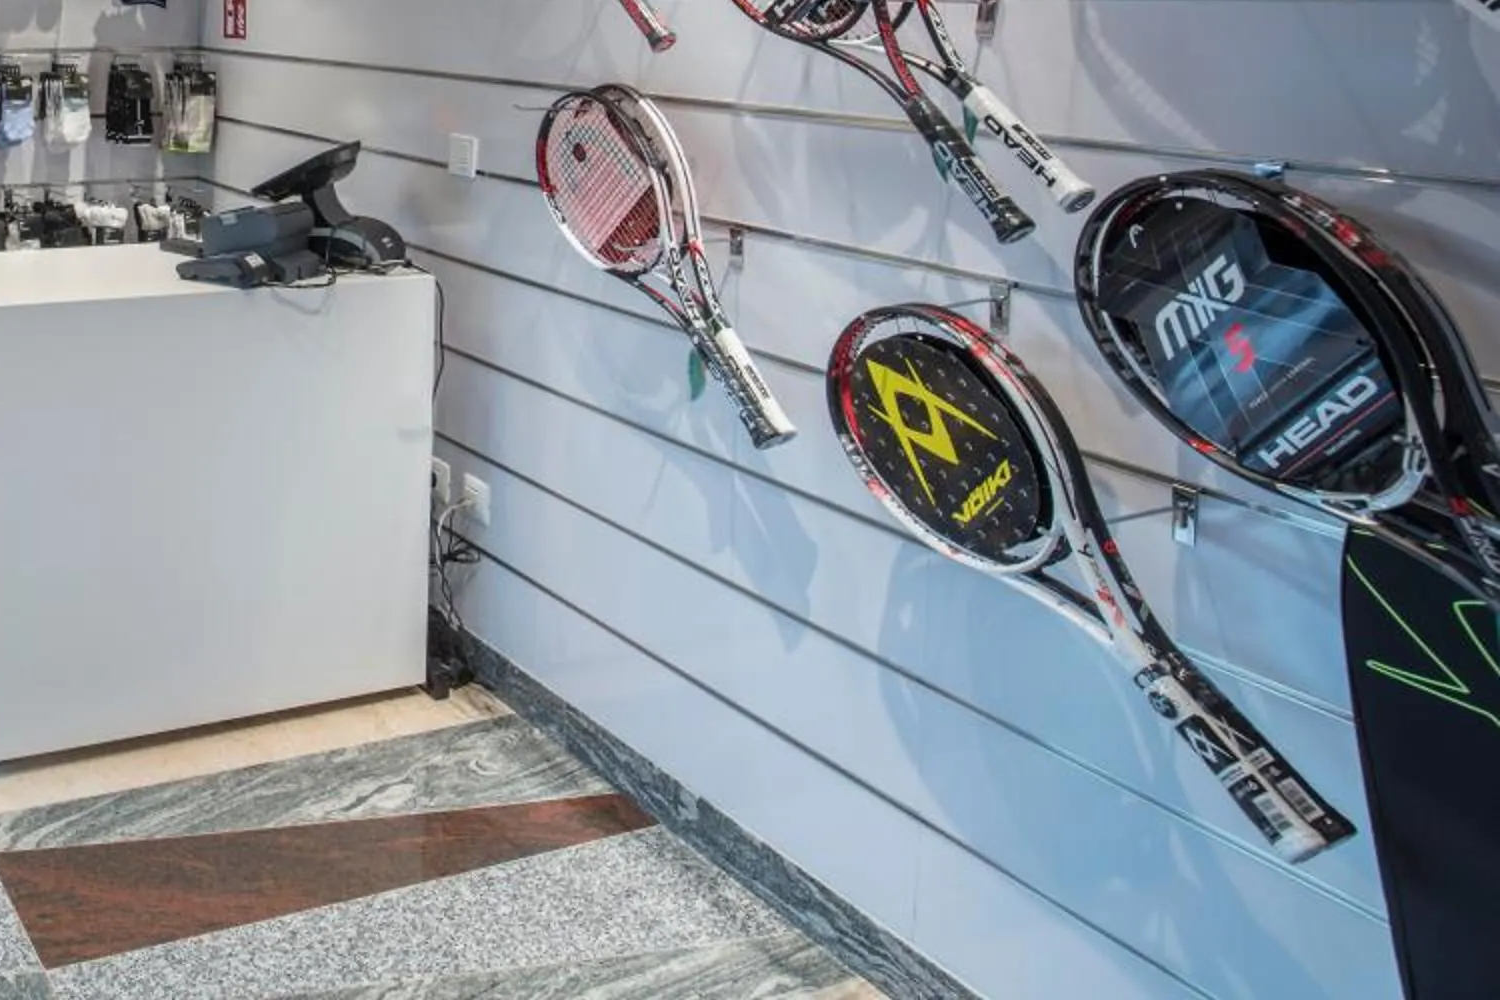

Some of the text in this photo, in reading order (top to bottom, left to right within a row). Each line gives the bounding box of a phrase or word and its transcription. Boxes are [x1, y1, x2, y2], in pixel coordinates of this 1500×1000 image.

[983, 114, 1057, 188] HEAD
[1154, 253, 1247, 361] MXG
[1258, 374, 1379, 470] HEAD
